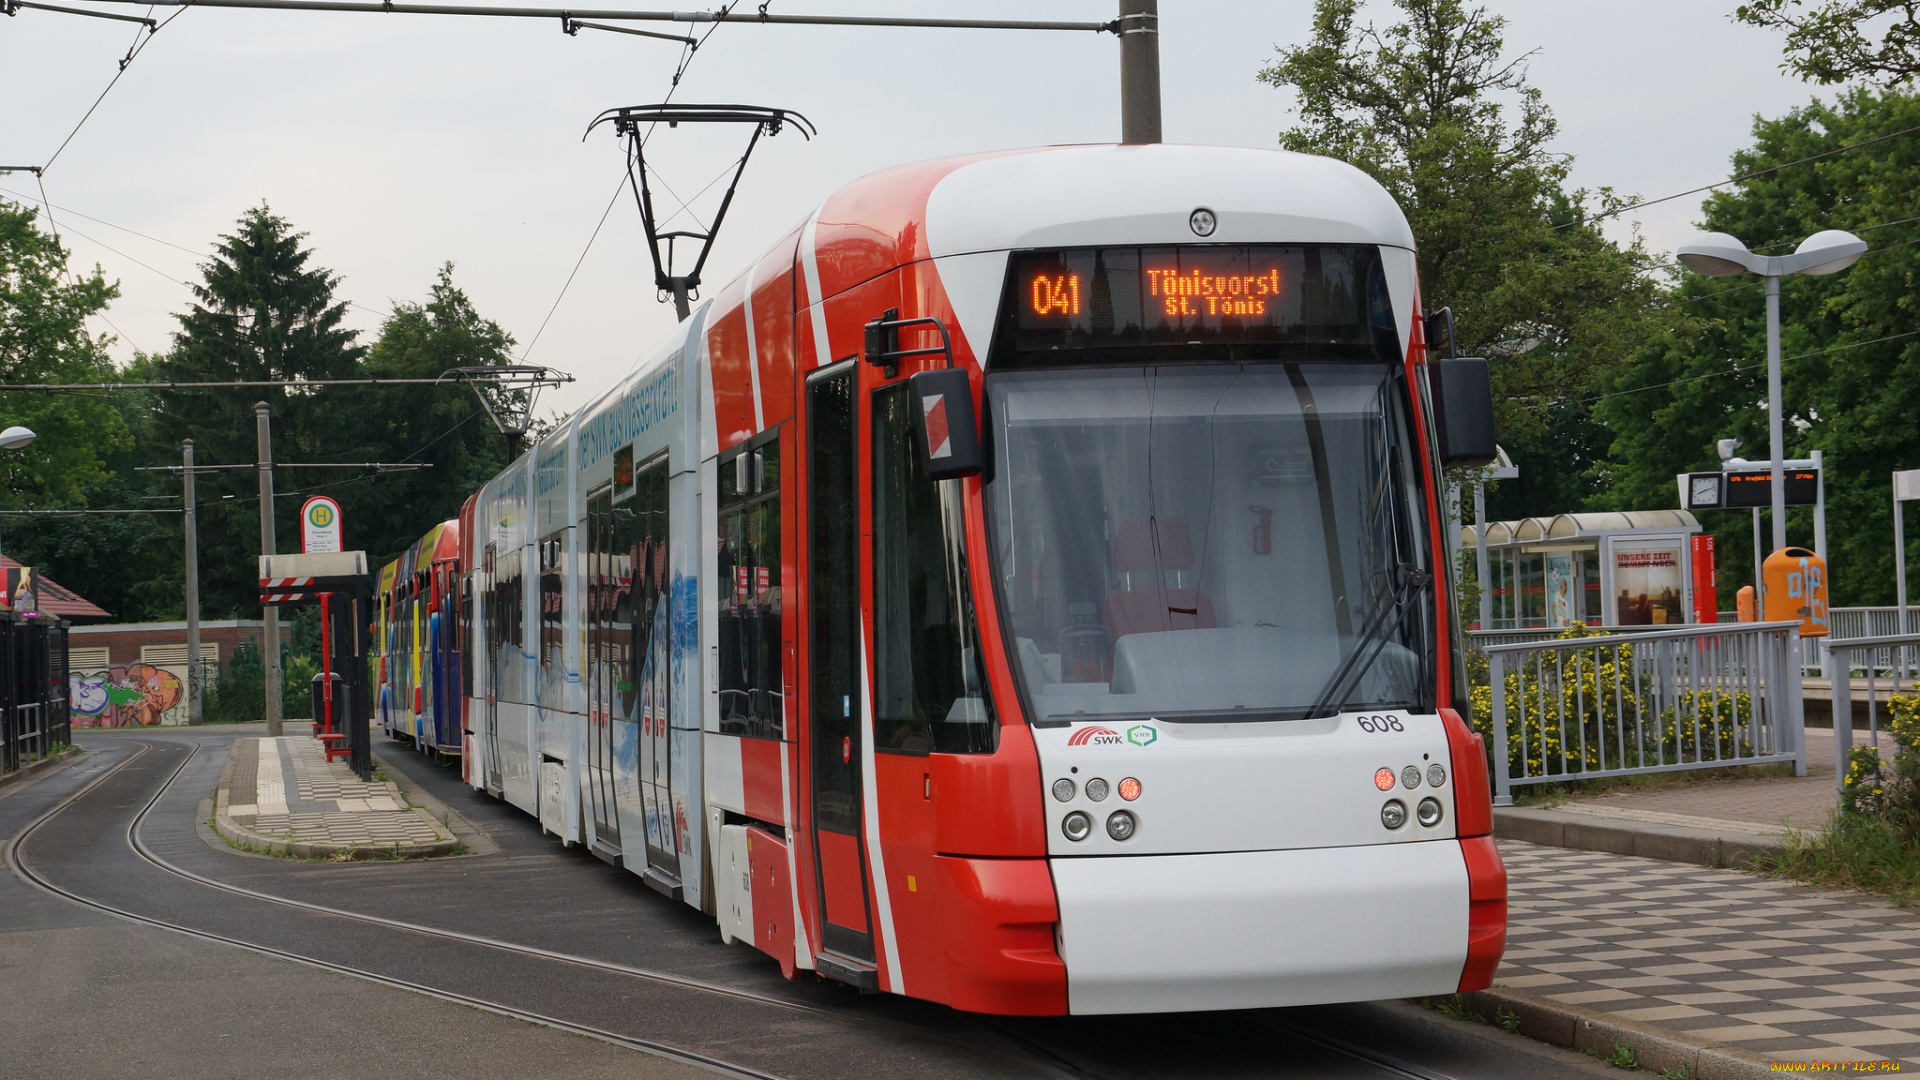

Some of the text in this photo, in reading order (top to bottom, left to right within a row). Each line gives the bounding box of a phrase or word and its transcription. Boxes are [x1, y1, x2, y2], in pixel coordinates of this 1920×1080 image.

[1147, 269, 1280, 295] Tönisvorst
[1033, 275, 1079, 315] 041
[1166, 296, 1265, 315] St. Tönis
[590, 410, 607, 465] SWK
[609, 406, 622, 453] aus
[623, 352, 678, 443] Wasserkraft!
[316, 509, 327, 523] H
[1617, 552, 1671, 561] UNSERE ZEIT
[1357, 714, 1405, 733] 608
[1094, 736, 1123, 745] SWK
